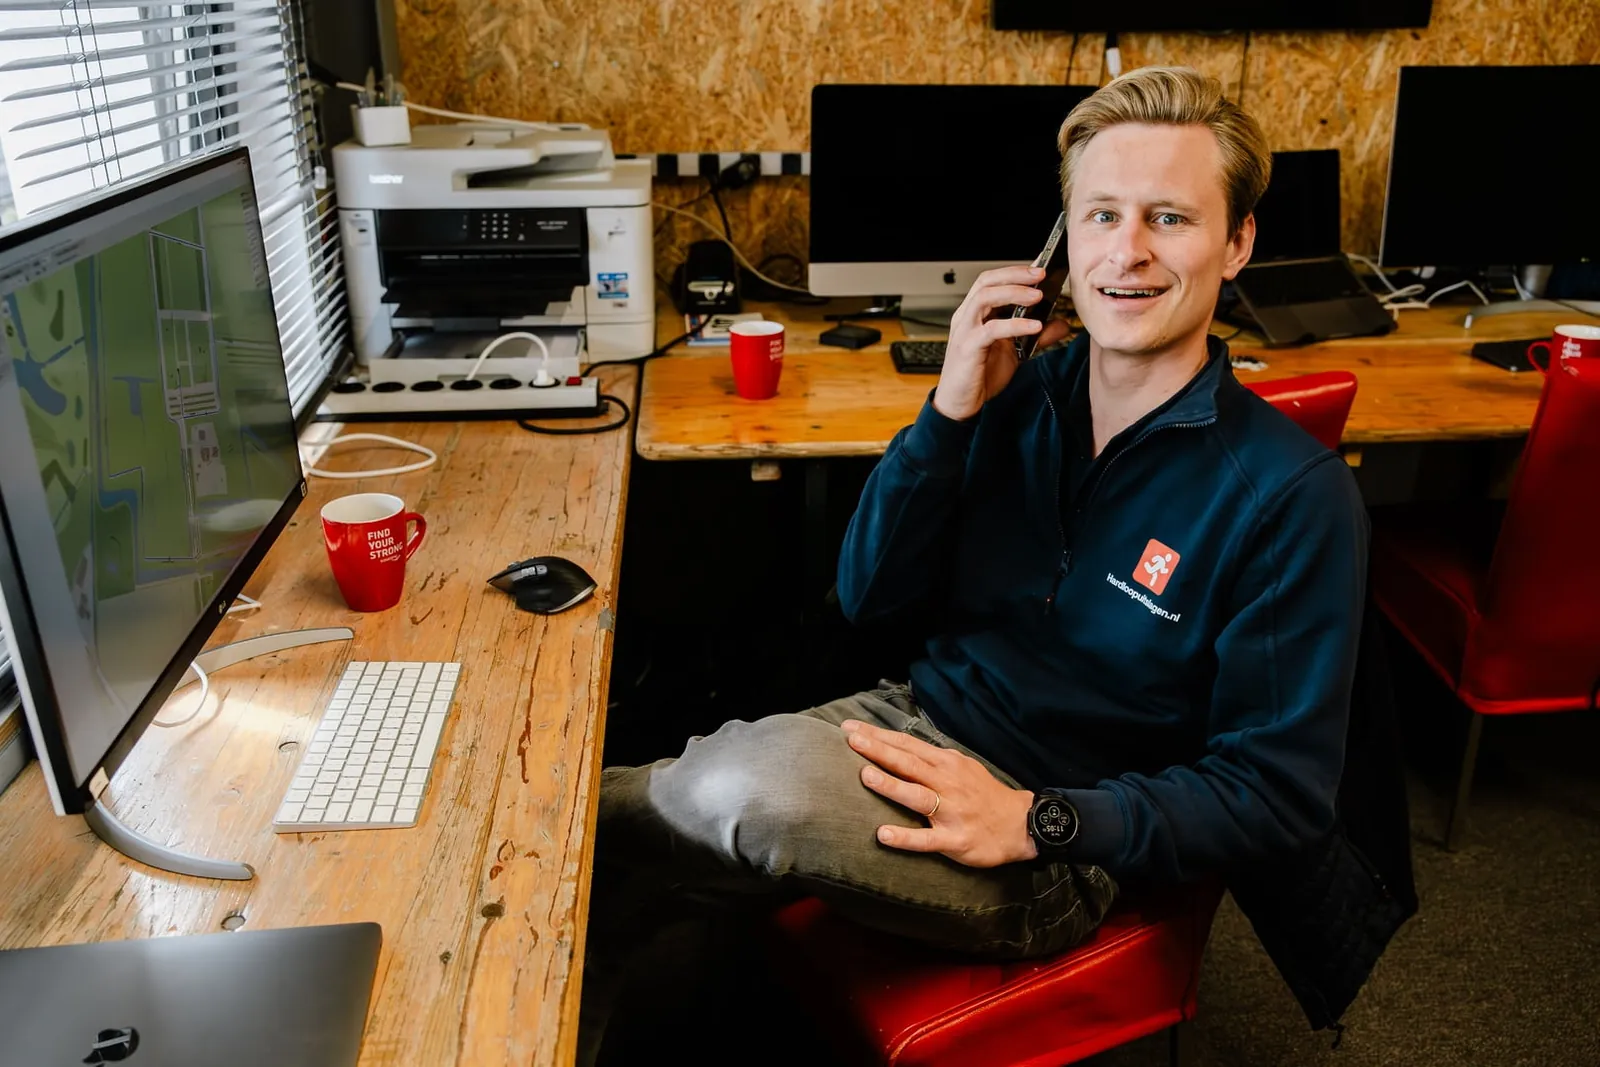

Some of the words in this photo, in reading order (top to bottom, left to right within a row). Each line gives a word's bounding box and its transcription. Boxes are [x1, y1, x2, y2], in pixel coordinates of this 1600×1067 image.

[367, 528, 390, 541] FIND
[368, 537, 394, 550] YOUR
[369, 541, 404, 560] STRONG
[1106, 572, 1181, 622] Hardloopuitslagen.nl
